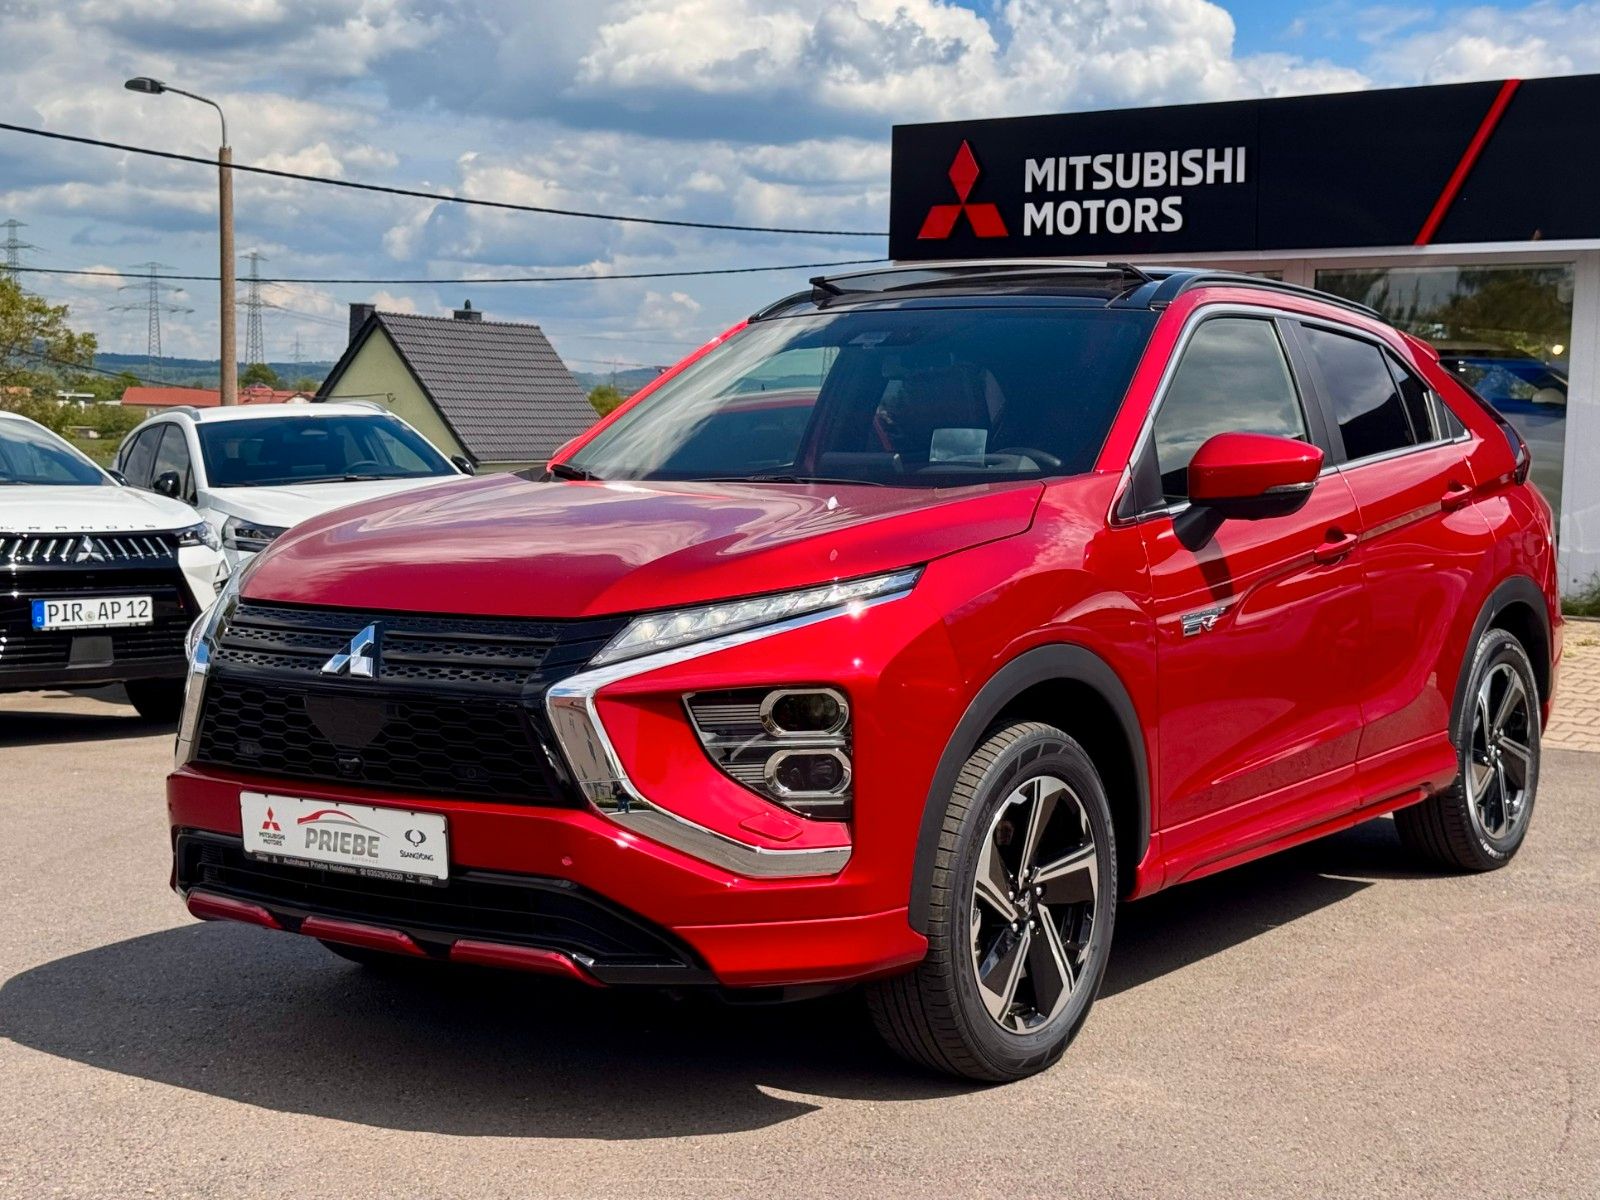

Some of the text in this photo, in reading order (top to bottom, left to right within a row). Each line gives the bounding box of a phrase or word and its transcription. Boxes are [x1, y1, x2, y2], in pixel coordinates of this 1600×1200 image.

[1024, 146, 1246, 193] MITSUBISHI
[1023, 196, 1183, 236] MOTORS
[47, 600, 149, 622] PIR AP 12
[305, 827, 380, 858] PRIEBE
